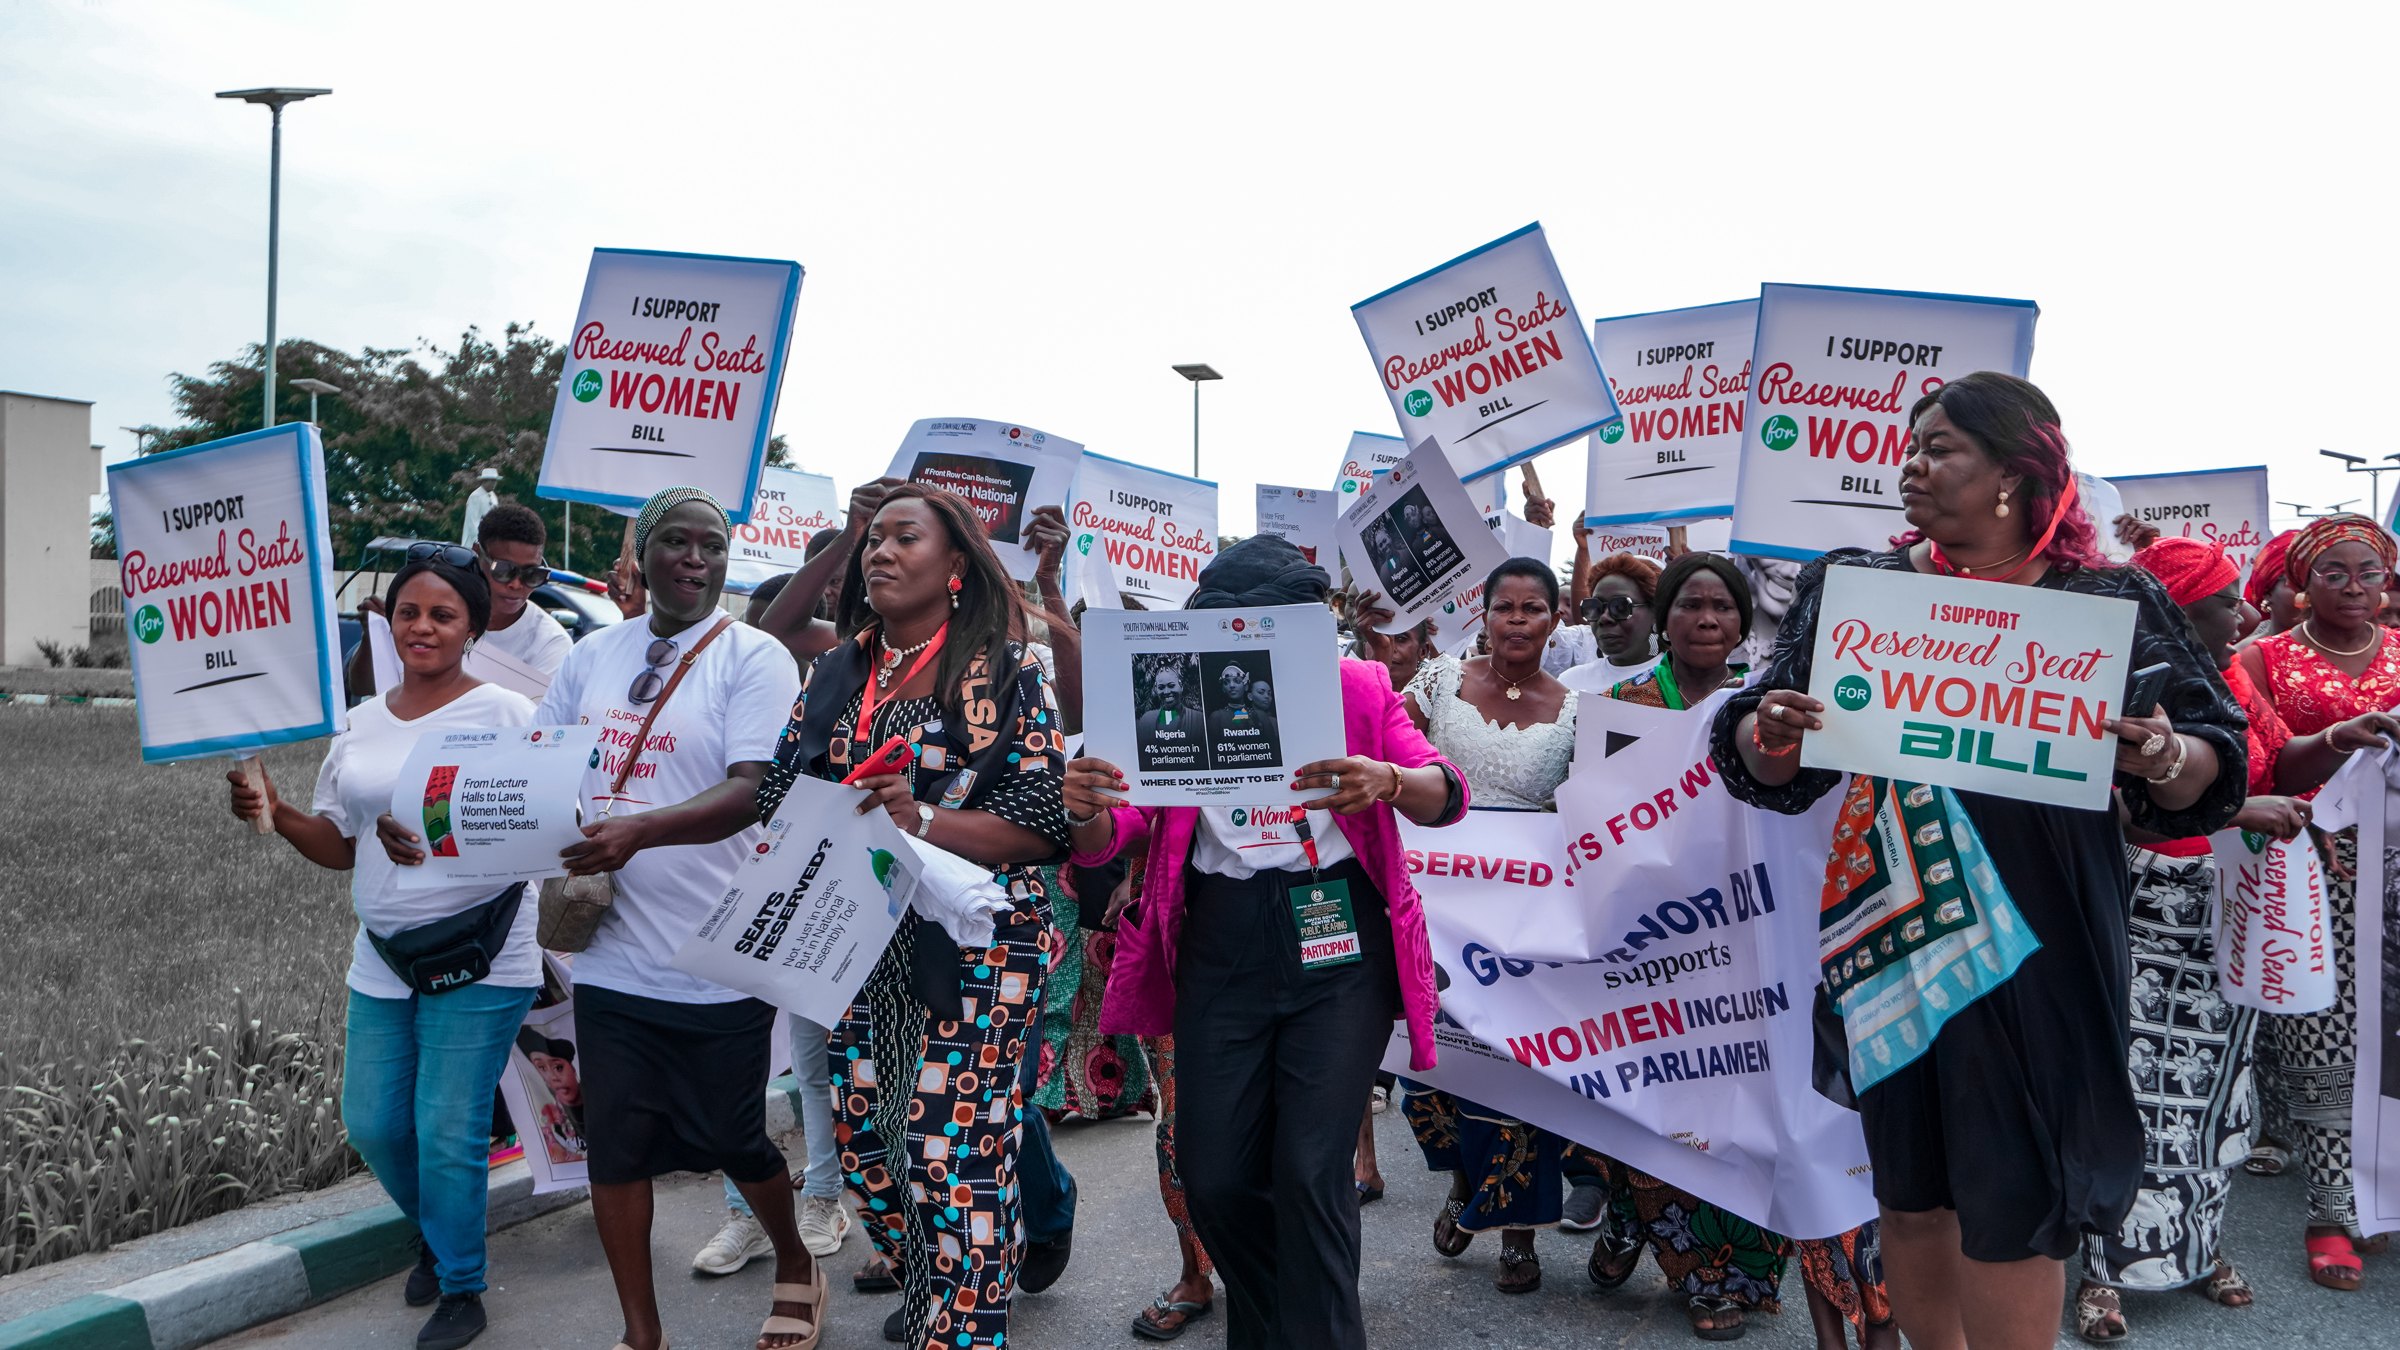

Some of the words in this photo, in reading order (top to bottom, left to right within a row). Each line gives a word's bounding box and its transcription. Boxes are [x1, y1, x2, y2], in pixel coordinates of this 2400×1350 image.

[632, 297, 639, 316] I
[642, 297, 720, 322] SUPPORT
[1415, 320, 1424, 336] I
[1425, 287, 1499, 332] SUPPORT
[573, 321, 692, 367] Reserved
[694, 331, 765, 373] Seats
[1384, 316, 1491, 391] Reserved
[1495, 291, 1567, 342] Seats
[1827, 336, 1835, 357] I
[1840, 337, 1942, 367] SUPPORT
[1637, 350, 1642, 367] I
[1646, 341, 1715, 366] SUPPORT
[1407, 394, 1431, 415] for
[1432, 330, 1563, 408] WOMEN
[1700, 359, 1751, 399] Seat
[576, 372, 601, 397] for
[609, 370, 740, 421] WOMEN
[1758, 362, 1907, 414] Reserved
[1478, 396, 1513, 418] BILL
[1602, 423, 1624, 443] for
[1630, 399, 1744, 443] WOMEN
[1765, 416, 1797, 445] for
[631, 424, 665, 442] BILL
[1371, 453, 1375, 461] I
[1657, 450, 1686, 464] BILL
[930, 468, 947, 477] Front
[946, 470, 961, 479] Row
[961, 472, 975, 481] Can
[975, 474, 984, 482] Be
[984, 475, 1012, 488] Reserved,
[1841, 475, 1883, 495] BILL
[946, 482, 970, 498] Not
[972, 485, 1017, 505] National
[1110, 489, 1114, 502] I
[1117, 491, 1173, 516] SUPPORT
[162, 510, 169, 533] I
[173, 495, 245, 531] SUPPORT
[777, 506, 837, 529] Seats
[2144, 504, 2210, 521] SUPPORT
[1073, 501, 1155, 542] Reserved
[1161, 522, 1213, 554] Seats
[2201, 520, 2262, 547] Seats
[121, 529, 230, 598] Reserved
[238, 520, 304, 576] Seats
[743, 548, 772, 559] BILL
[1104, 537, 1198, 582] WOMEN
[1423, 540, 1443, 557] Rwanda
[1435, 546, 1453, 561] women
[1391, 566, 1409, 582] Nigeria
[1434, 552, 1458, 574] parliament
[1126, 576, 1150, 590] BILL
[1399, 574, 1416, 589] women
[1400, 580, 1422, 600] parliament
[1405, 600, 1424, 614] WHERE
[1422, 594, 1431, 603] DO
[1429, 588, 1440, 597] WE
[1438, 577, 1454, 591] WANT
[1453, 571, 1462, 580] TO
[1461, 563, 1472, 574] BE?
[138, 608, 163, 632] for
[168, 578, 291, 641] WOMEN
[1469, 603, 1485, 615] BILL
[1930, 603, 1938, 620] I
[1940, 604, 2020, 630] SUPPORT
[1123, 622, 1139, 632] YOUTH
[1139, 622, 1155, 632] TOWN
[1155, 622, 1167, 632] HALL
[1168, 621, 1189, 631] MEETING
[206, 650, 237, 670] BILL
[1832, 619, 2002, 672] Reserved
[2005, 641, 2114, 685] Seat
[606, 708, 611, 717] I
[1837, 686, 1867, 700] FOR
[1881, 669, 2108, 740] WOMEN
[1155, 729, 1186, 741] Nigeria
[1223, 727, 1260, 737] Rwanda
[1145, 744, 1158, 753] 4%
[1160, 745, 1190, 753] women
[1192, 744, 1200, 752] in
[1217, 743, 1236, 752] 61%
[1237, 742, 1270, 751] women
[1217, 753, 1226, 762] in
[1227, 751, 1272, 764] parliament
[1899, 720, 2088, 782] BILL
[1151, 755, 1195, 766] parliament
[464, 778, 489, 789] From
[490, 777, 528, 789] Lecture
[1178, 778, 1197, 786] DO
[1213, 776, 1244, 784] WANT
[1263, 774, 1284, 782] BE?
[461, 792, 485, 803] Halls
[487, 793, 497, 802] to
[498, 791, 526, 804] Laws,
[460, 806, 498, 817] Women
[499, 805, 525, 816] Need
[1233, 811, 1245, 824] for
[1605, 787, 1679, 845] FOR
[462, 819, 507, 831] Reserved
[508, 819, 539, 831] Seats!
[1261, 832, 1280, 840] BILL
[1884, 827, 1900, 868] NIGERIA)
[753, 837, 833, 962] RESERVED?
[1861, 898, 1887, 918] NIGERIA)
[734, 891, 785, 955] SEATS
[782, 947, 801, 967] Not
[796, 922, 815, 946] Just
[807, 911, 821, 921] in
[815, 878, 842, 909] Class,
[2224, 898, 2233, 927] BILL
[2307, 860, 2325, 975] SUPPORT
[794, 951, 813, 969] But
[805, 940, 819, 950] in
[812, 895, 845, 938] National
[809, 924, 846, 973] Assembly
[837, 899, 859, 922] Too!
[1300, 926, 1321, 936] PUBLIC
[1322, 920, 1347, 933] HEARING
[2226, 863, 2262, 988] Women
[1301, 938, 1354, 960] PARTICIPANT
[1603, 940, 1732, 990] supports
[2261, 939, 2298, 1005] Seats
[429, 969, 473, 990] FILA
[1436, 1034, 1470, 1047] DOUYE
[1471, 1041, 1492, 1052] DIRI
[1438, 1028, 1475, 1040] Excellency
[1505, 998, 1685, 1069] WOMEN
[1464, 1046, 1491, 1058] Bayelsa
[1492, 1053, 1510, 1063] State
[1569, 1070, 1611, 1100] IN
[1615, 1039, 1771, 1093] PARLIAMEN
[1672, 1131, 1694, 1139] SUPPORT
